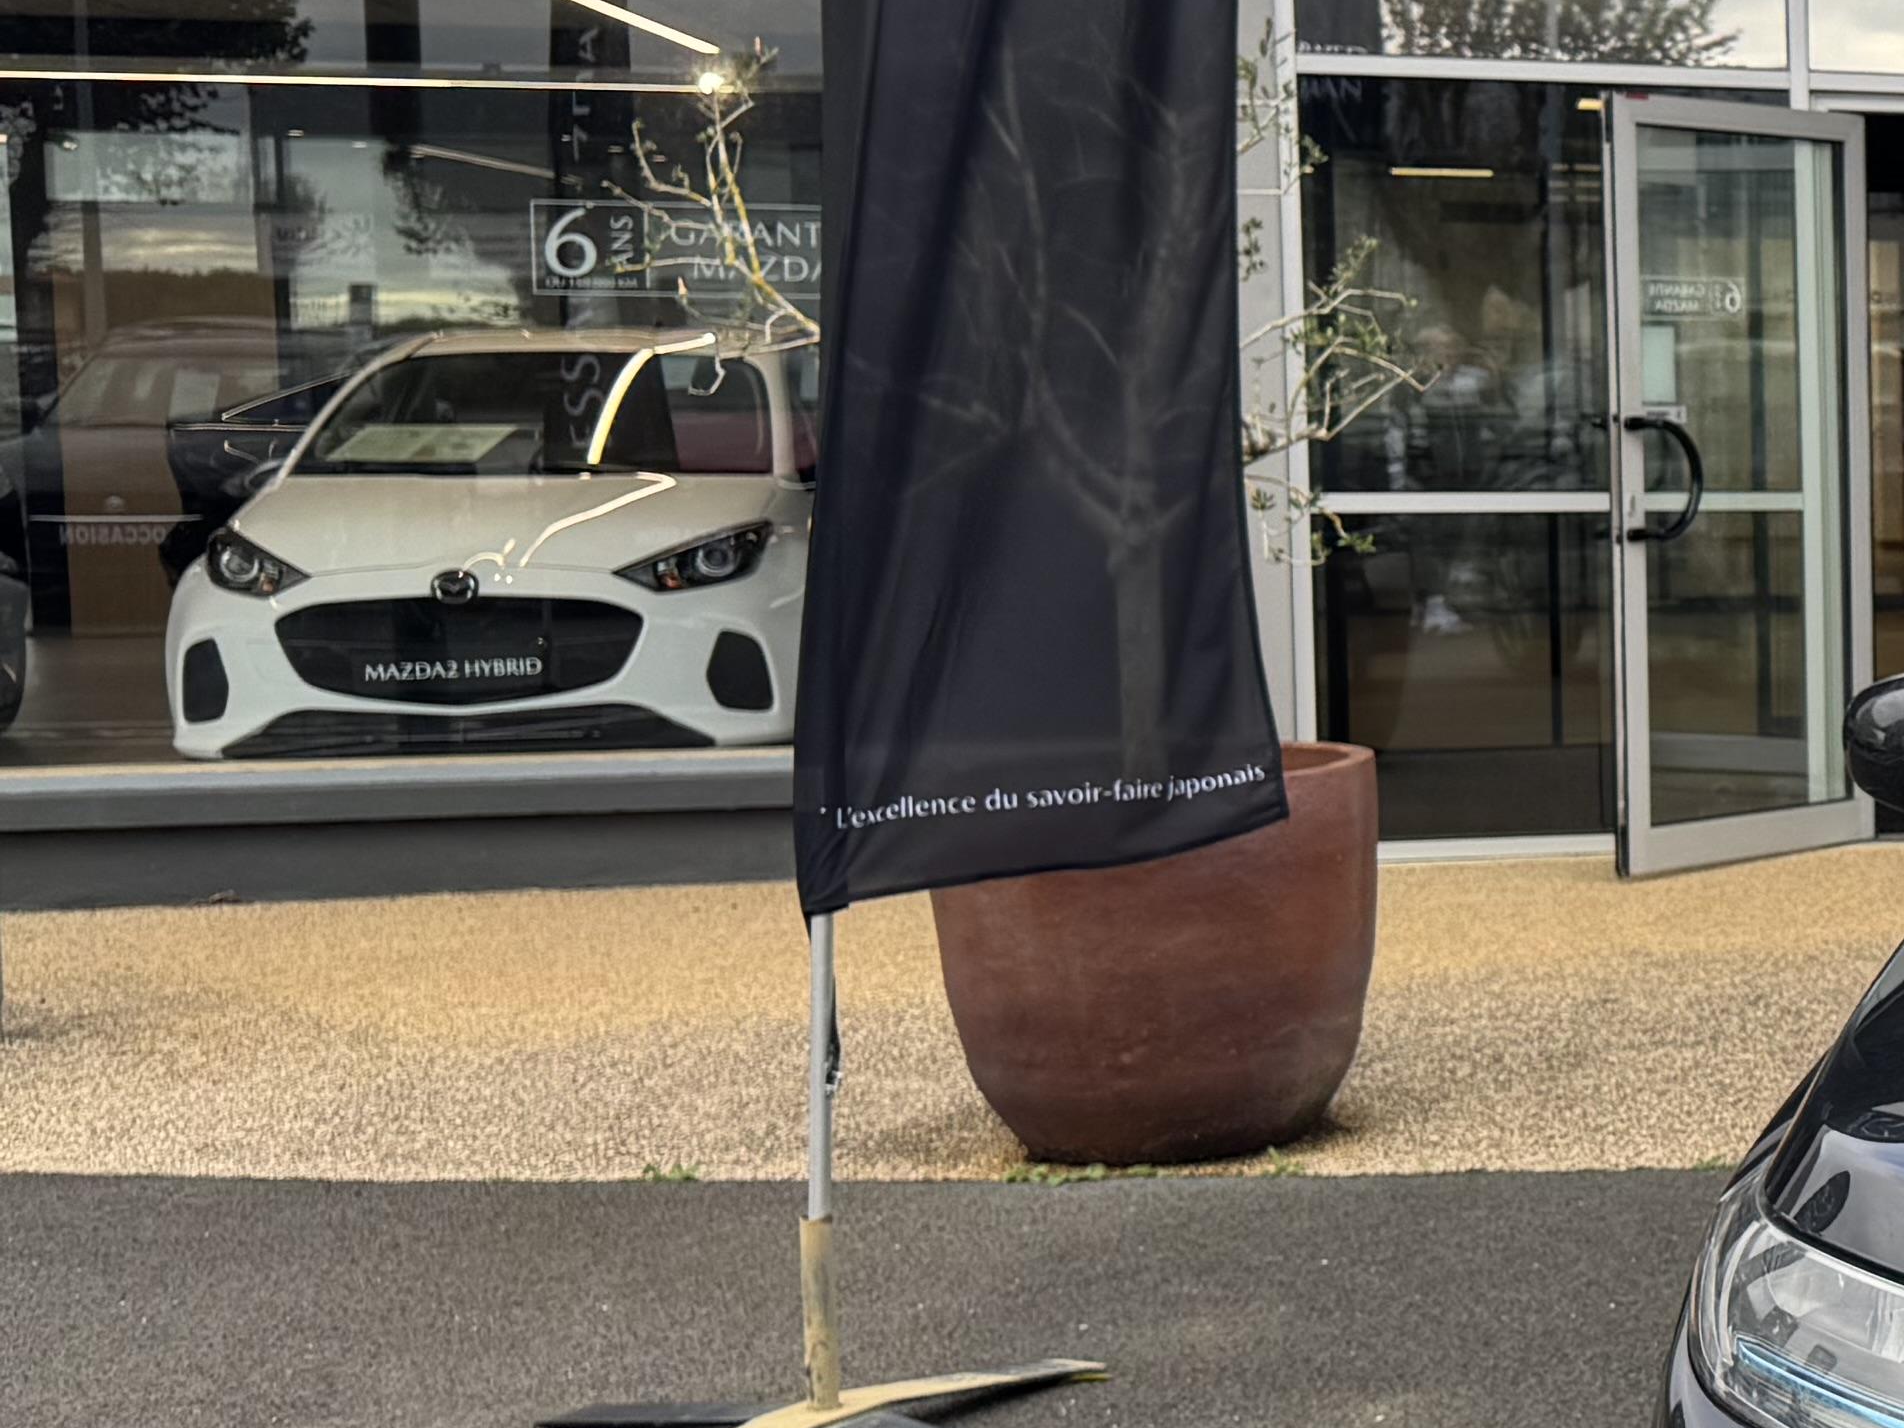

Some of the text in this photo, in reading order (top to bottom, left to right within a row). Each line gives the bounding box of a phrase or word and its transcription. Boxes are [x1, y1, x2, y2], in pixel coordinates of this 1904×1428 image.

[545, 208, 635, 277] 6 ANS
[364, 656, 543, 682] MAZDA2 HYBRID
[836, 762, 1266, 830] L'excellence du savoir-faire japonais
